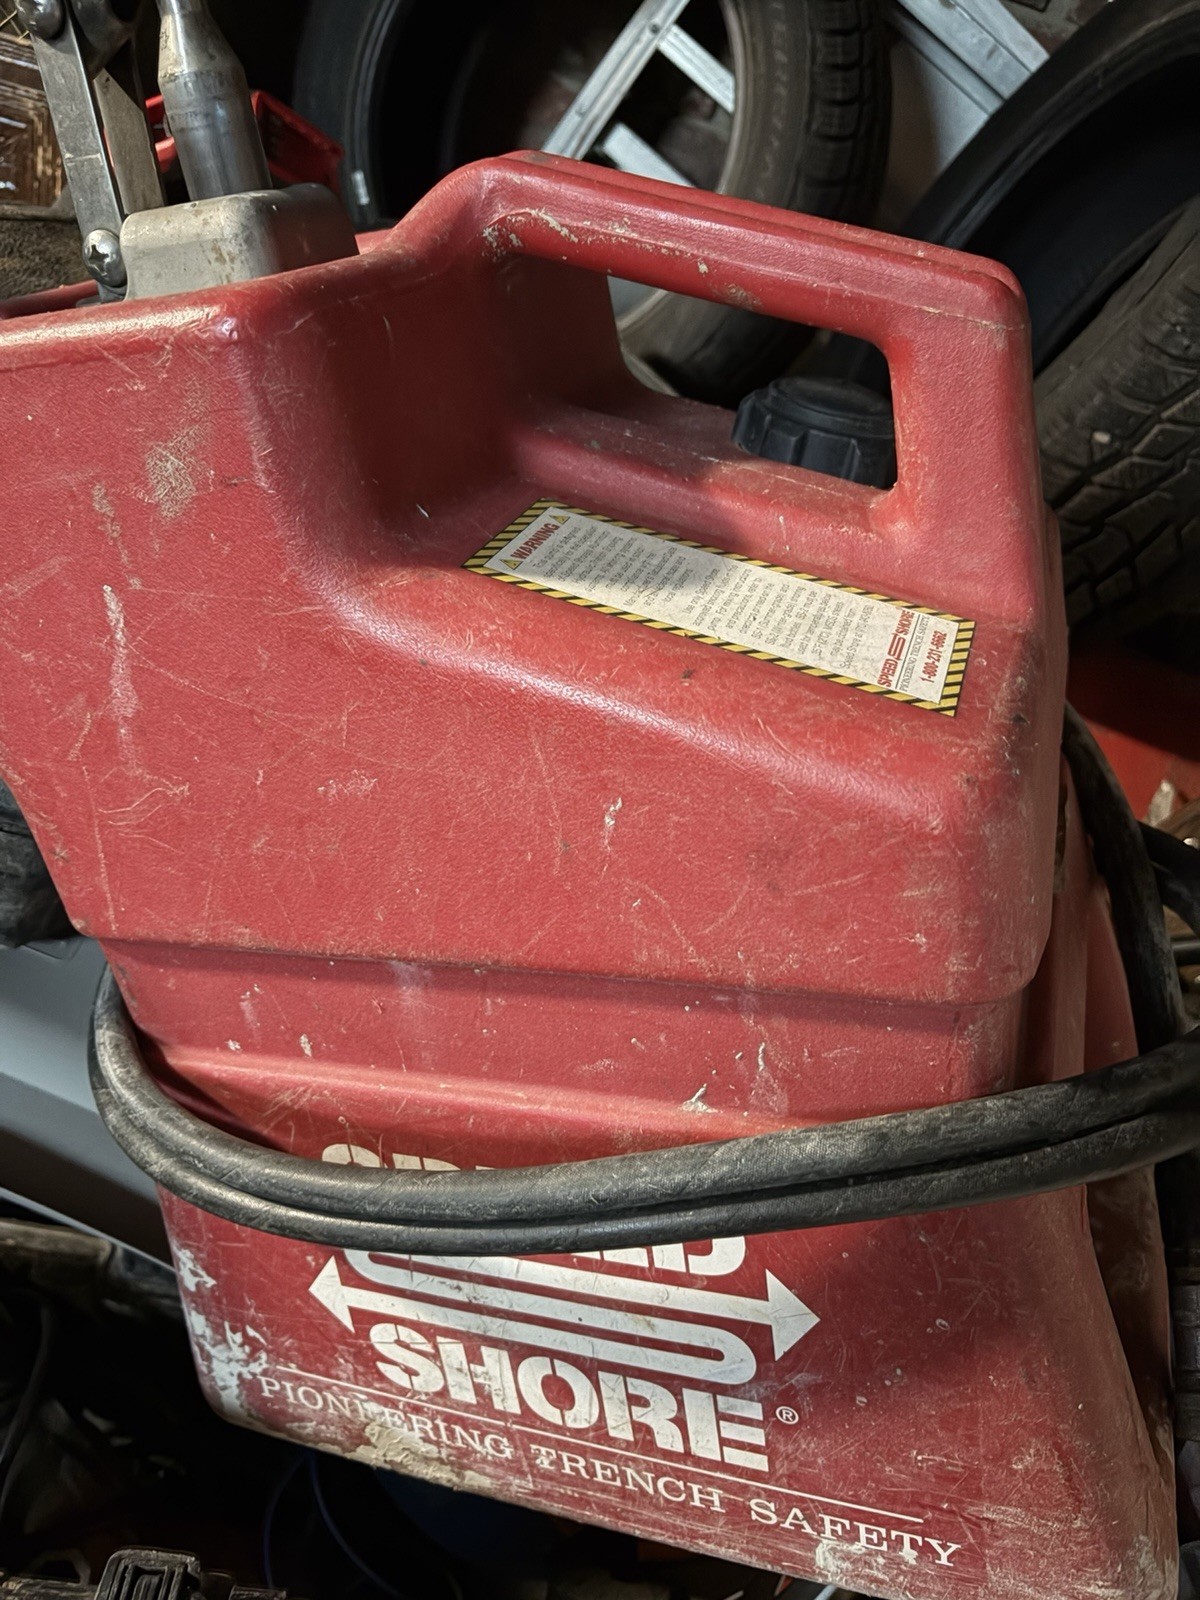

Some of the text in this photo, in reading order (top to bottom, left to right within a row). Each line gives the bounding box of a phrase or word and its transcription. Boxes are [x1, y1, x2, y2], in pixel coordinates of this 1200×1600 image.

[511, 522, 560, 560] WARNING
[877, 609, 915, 687] SPEED SHORE
[899, 657, 917, 691] PIONEERING
[919, 630, 947, 683] 1-800-231-6662
[369, 1322, 769, 1472] SHORE
[528, 1443, 727, 1512] TRENCH
[749, 1498, 962, 1568] SAFETY
